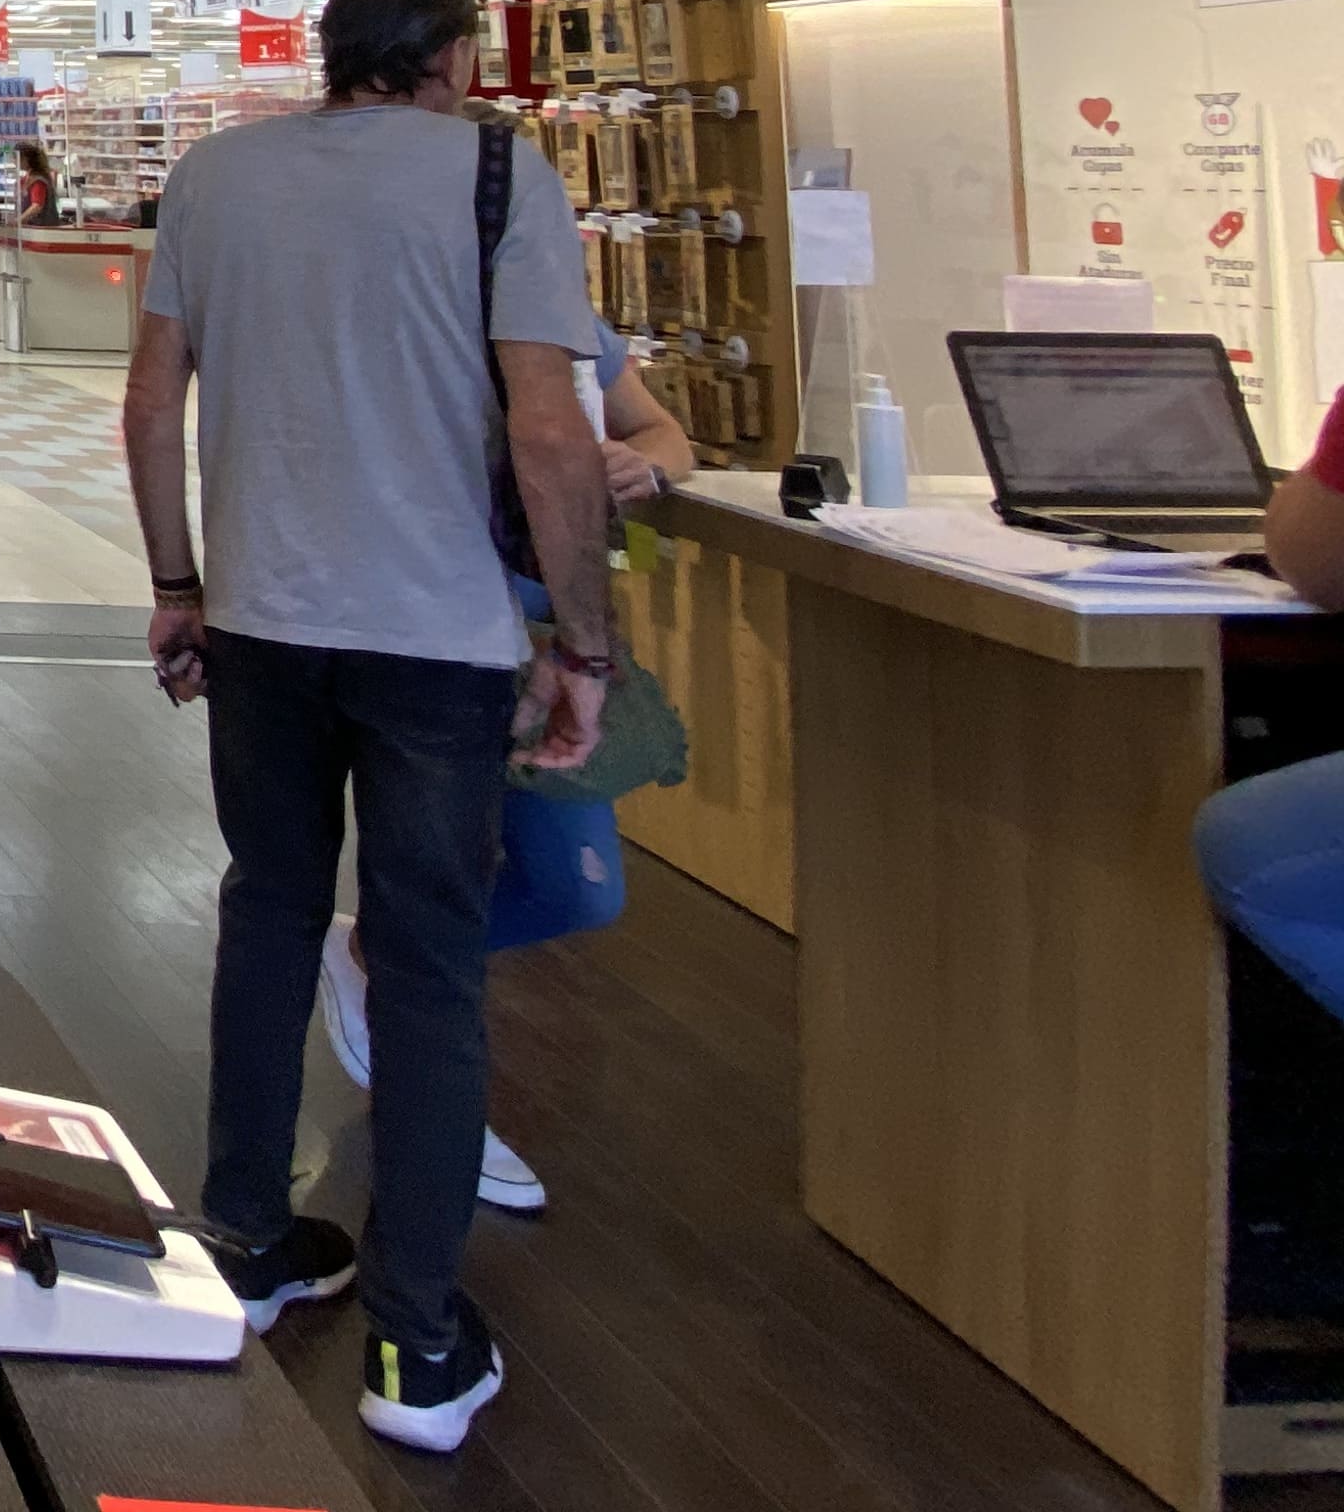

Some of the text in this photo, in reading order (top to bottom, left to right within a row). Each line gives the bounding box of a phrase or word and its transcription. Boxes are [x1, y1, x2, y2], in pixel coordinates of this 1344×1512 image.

[1071, 144, 1134, 156] Acumula
[1183, 143, 1262, 159] Comparte
[1083, 160, 1122, 175] Gigas
[1200, 159, 1244, 175] Gigas
[1097, 250, 1121, 263] Sin
[1205, 256, 1255, 269] Precio
[1210, 272, 1250, 287] Final
